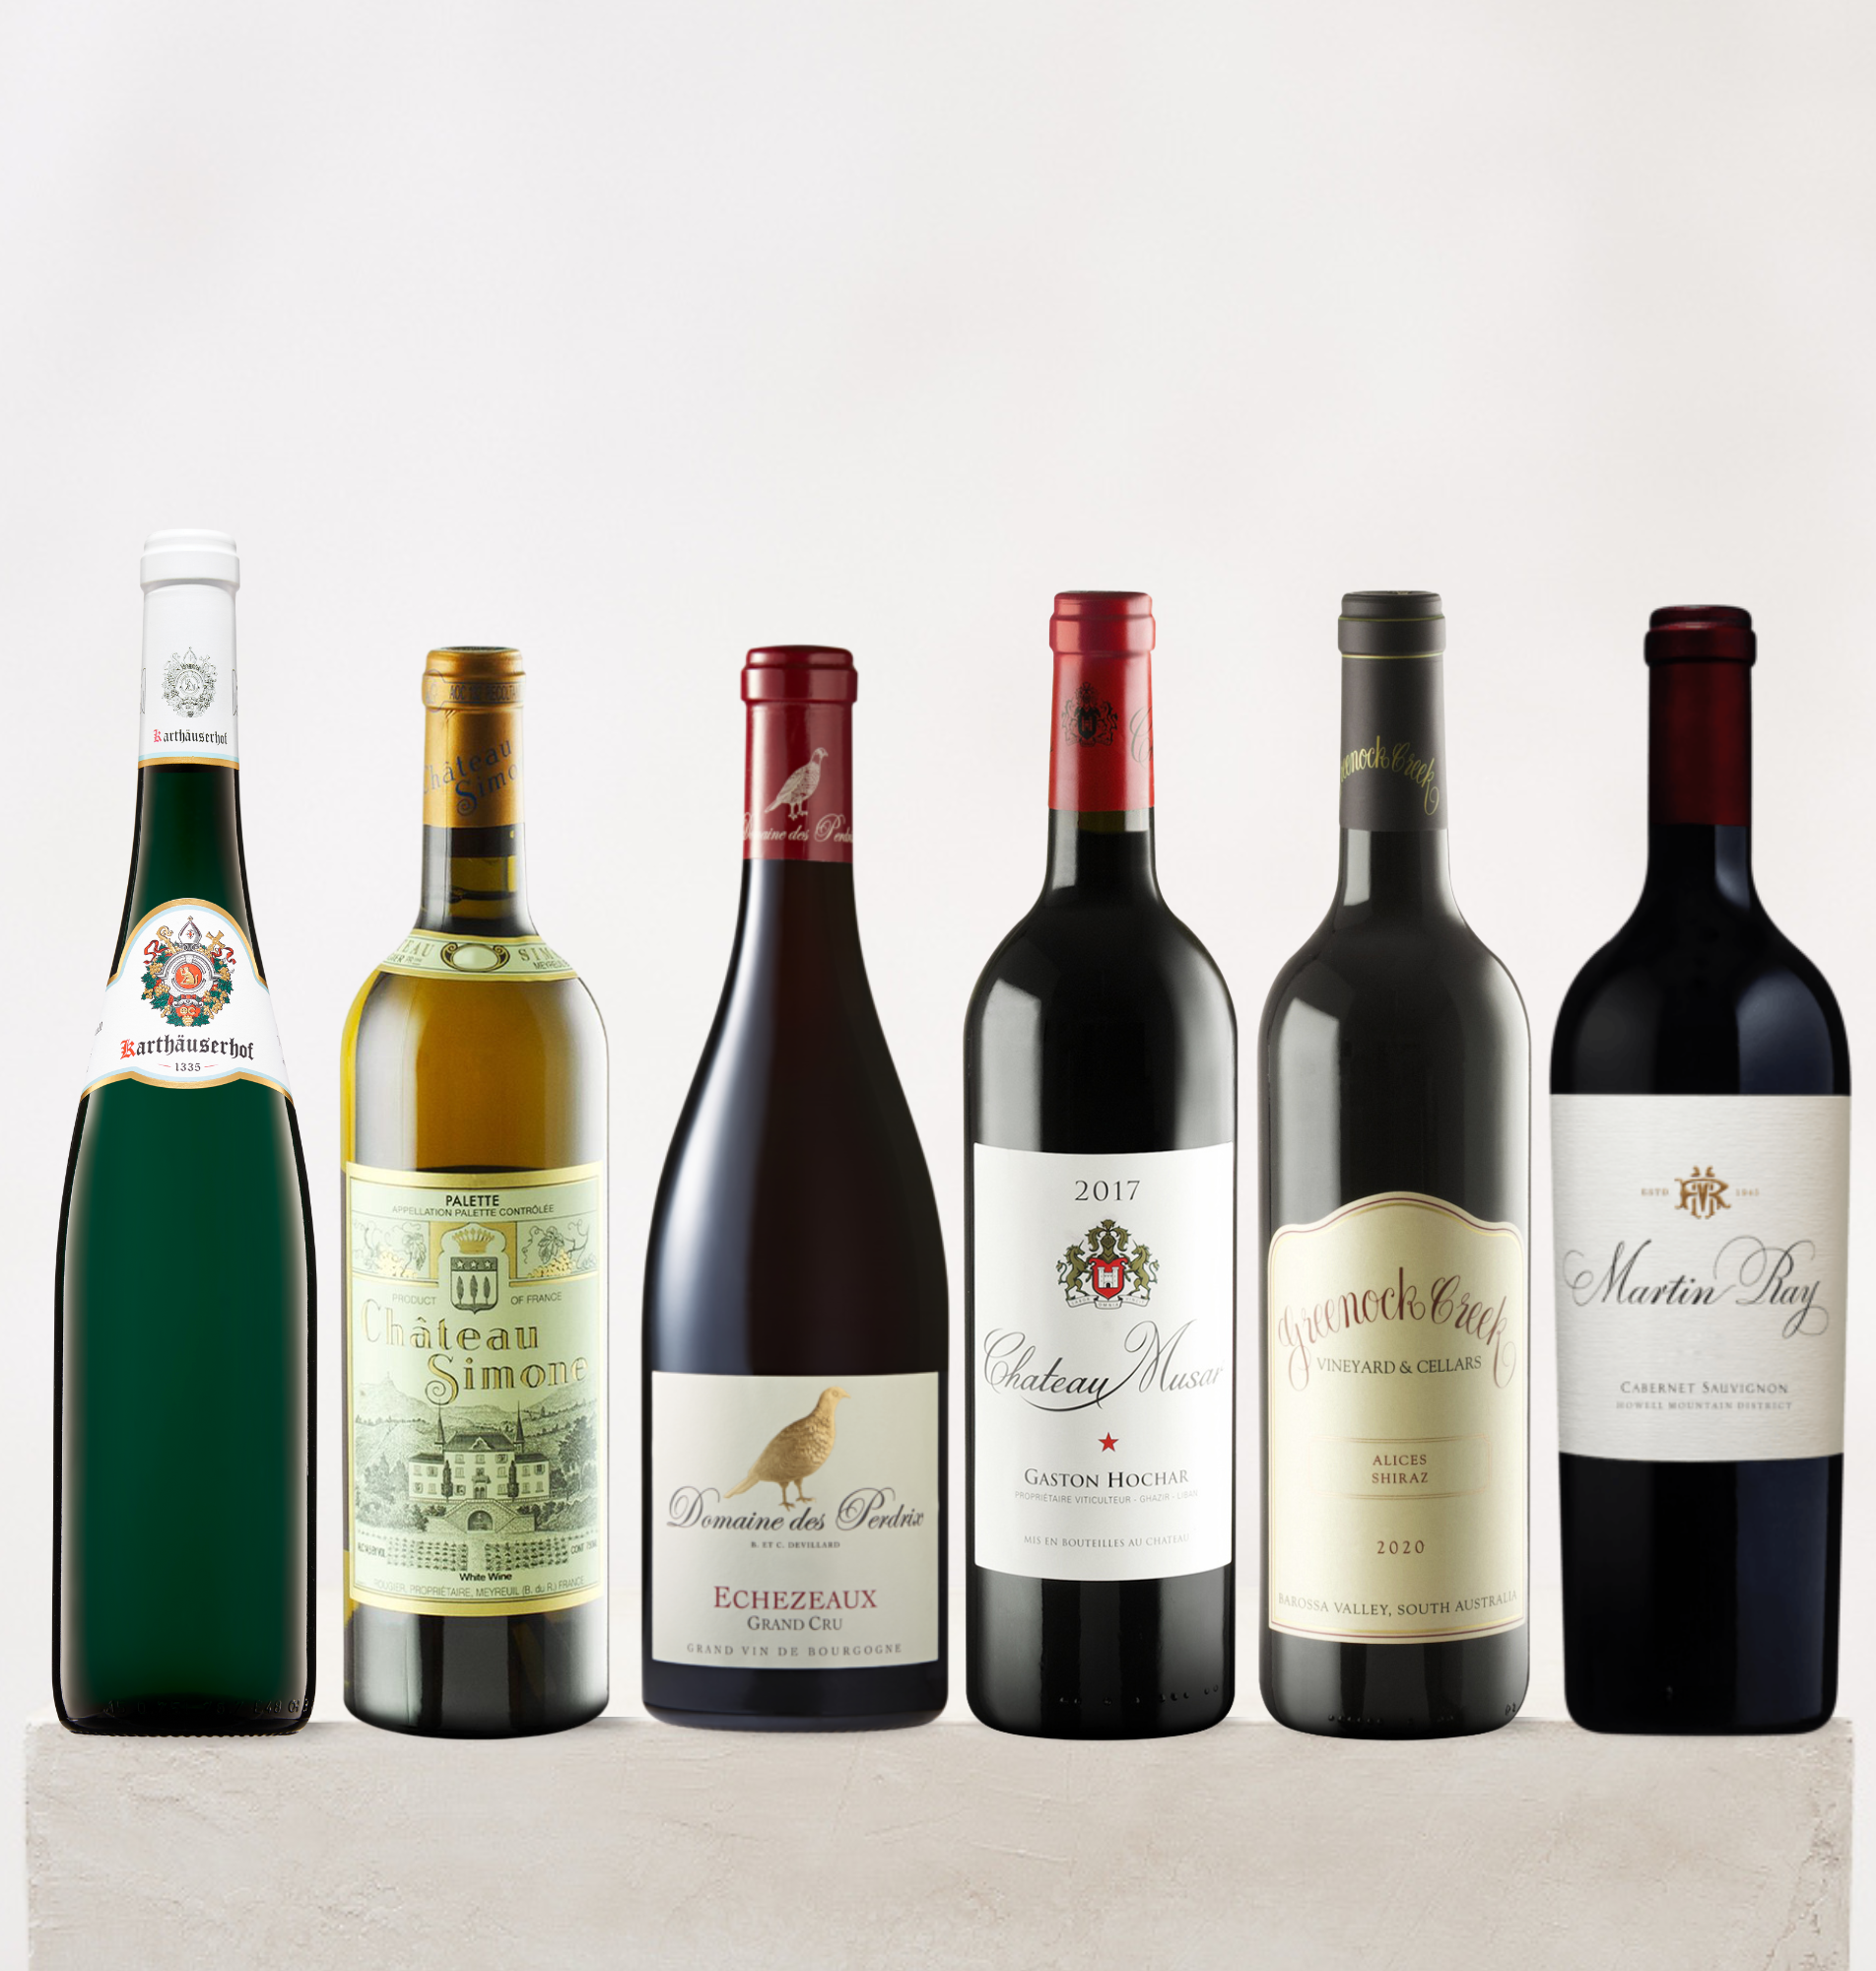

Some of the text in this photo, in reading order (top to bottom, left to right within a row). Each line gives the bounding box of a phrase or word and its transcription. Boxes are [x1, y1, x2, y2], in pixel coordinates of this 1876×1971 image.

[153, 729, 228, 745] Karthäuserhof
[788, 825, 809, 841] des
[119, 1034, 254, 1060] Karthäuserhof
[174, 1062, 201, 1072] 1335
[1074, 1181, 1141, 1202] 2017
[445, 1194, 500, 1207] PALETTE
[392, 1204, 555, 1217] APPELLATION PALETTE CONTRÔLÉE
[1562, 1235, 1830, 1339] Martin Ray
[392, 1292, 563, 1306] PRODUCT OF FRANCE
[362, 1299, 539, 1351] Château
[1431, 1274, 1517, 1390] Creek
[983, 1319, 1225, 1410] Chateau Musar
[1316, 1355, 1482, 1375] VINEYARD & CELLARS
[425, 1353, 588, 1406] Simone
[1620, 1381, 1789, 1394] CABERNET SAUVIGNON
[1616, 1400, 1793, 1410] HOWELL MOUNTAIN DISTRICT
[1373, 1454, 1428, 1466] ALICES
[1025, 1468, 1189, 1488] GASTON HOCHAR
[1371, 1472, 1429, 1484] SHIRAZ
[1015, 1490, 1072, 1504] PROPRIÉTAIRE
[1075, 1495, 1131, 1504] VITICULTEUR
[1139, 1493, 1171, 1504] GHAZIR
[1176, 1489, 1199, 1500] LIBAN
[666, 1486, 924, 1531] Domaine des Perdrix
[750, 1540, 760, 1549] B.
[1023, 1533, 1190, 1548] MIS EN BOUTEILLES AU CHATEAU
[1376, 1539, 1426, 1554] 2020
[459, 1573, 512, 1582] White Wine
[409, 1585, 474, 1597] PROPRIÉTAIRE,
[476, 1586, 520, 1597] MEYREUIL
[535, 1584, 545, 1594] du
[558, 1576, 584, 1590] FRANCE
[713, 1586, 878, 1610] ECHEZEAUX
[1278, 1590, 1518, 1618] BAROSSA VALLEY, SOUTH AUSTRALIA
[747, 1615, 843, 1631] GRAND CRU
[687, 1643, 903, 1658] GRAND VIN DE BOURGOGNE
